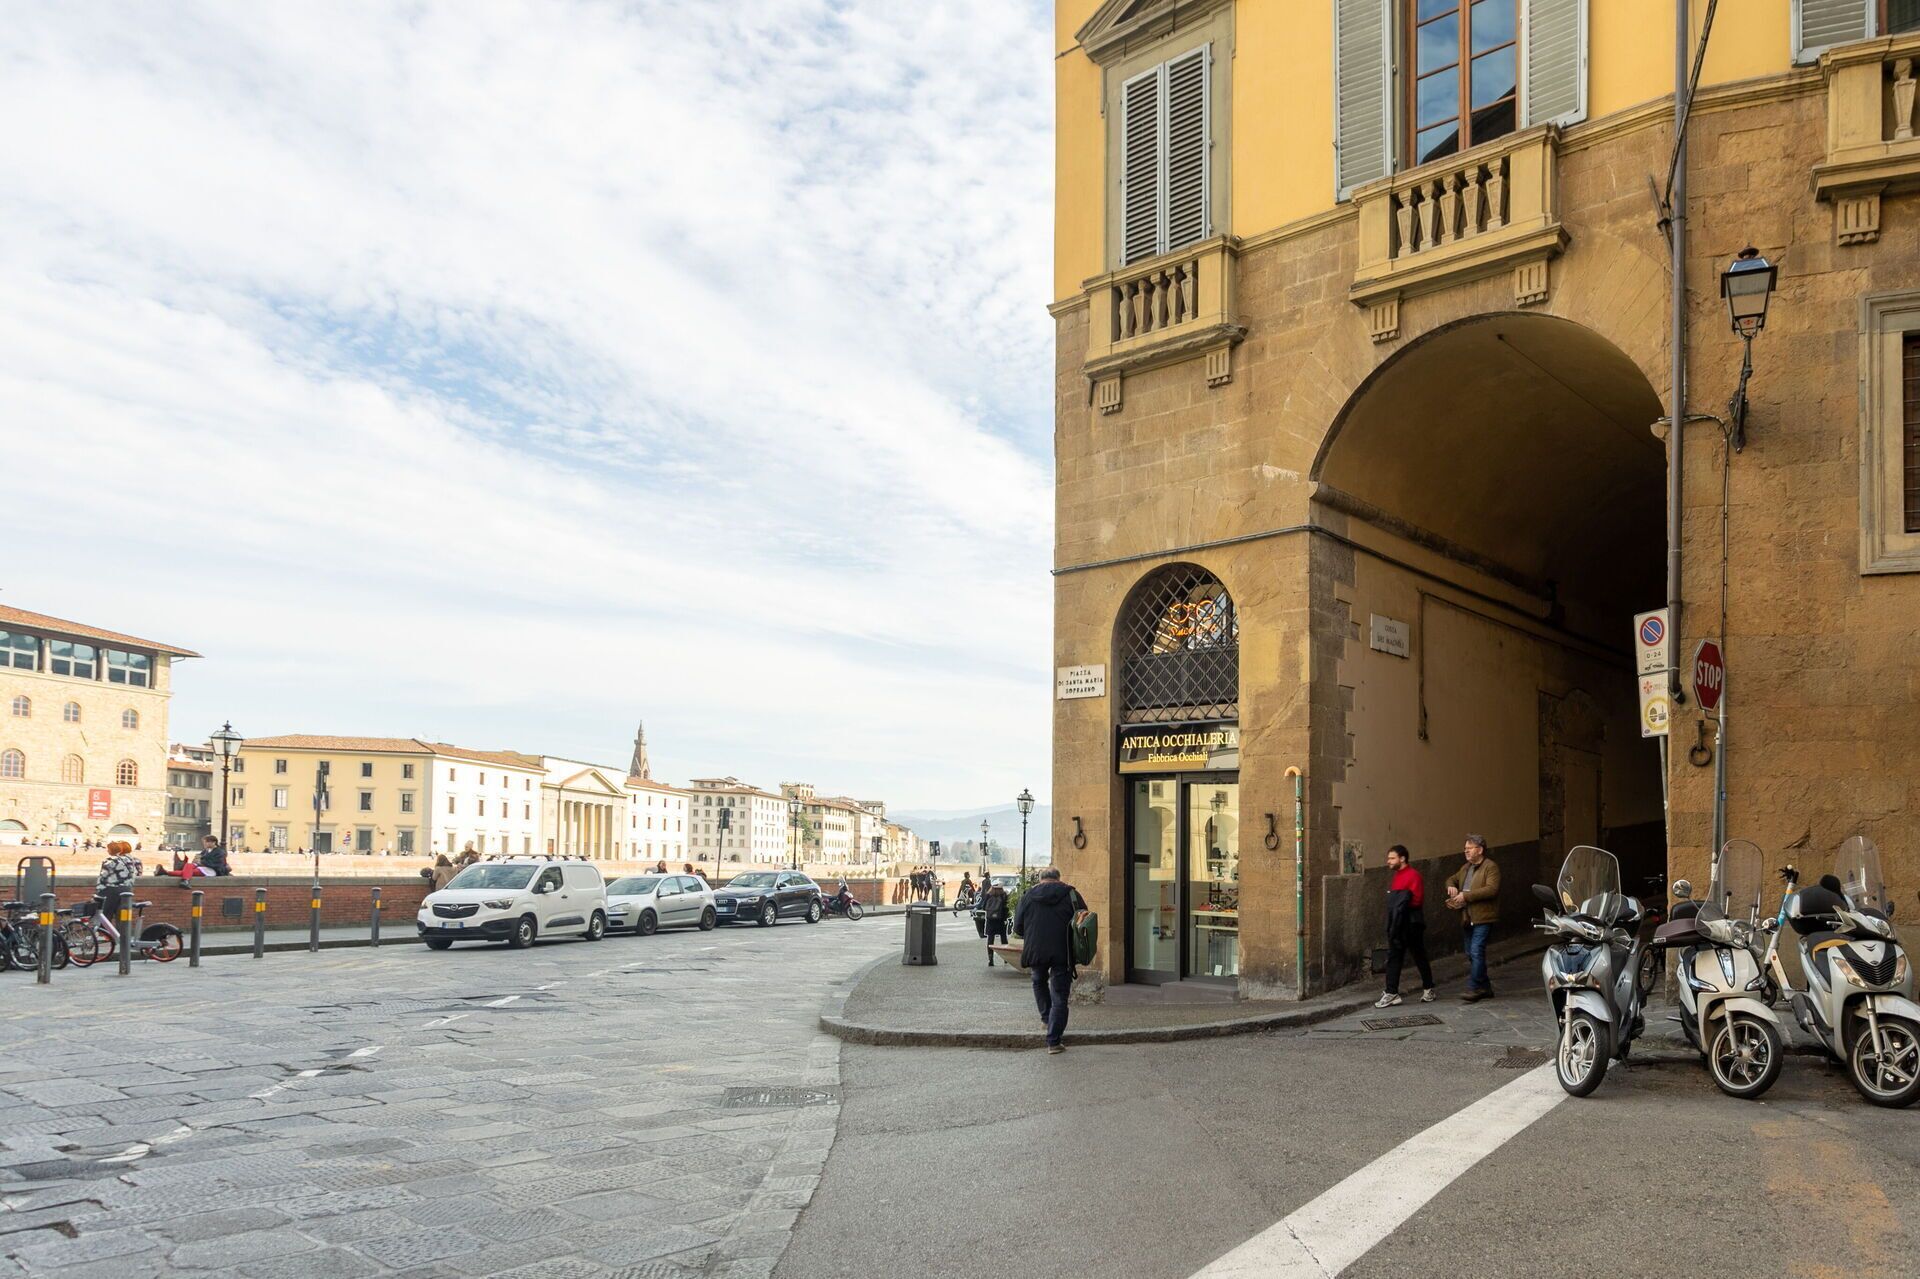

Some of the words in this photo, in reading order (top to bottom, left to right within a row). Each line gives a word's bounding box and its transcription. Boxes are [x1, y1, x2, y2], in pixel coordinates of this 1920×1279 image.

[1696, 660, 1721, 690] STOP
[1065, 686, 1096, 694] SOPRARNO
[1122, 735, 1160, 749] ANTICA
[1162, 732, 1237, 748] OCCHIALERIA
[1148, 752, 1178, 763] Fabbrica
[1178, 751, 1208, 762] Occhiali
